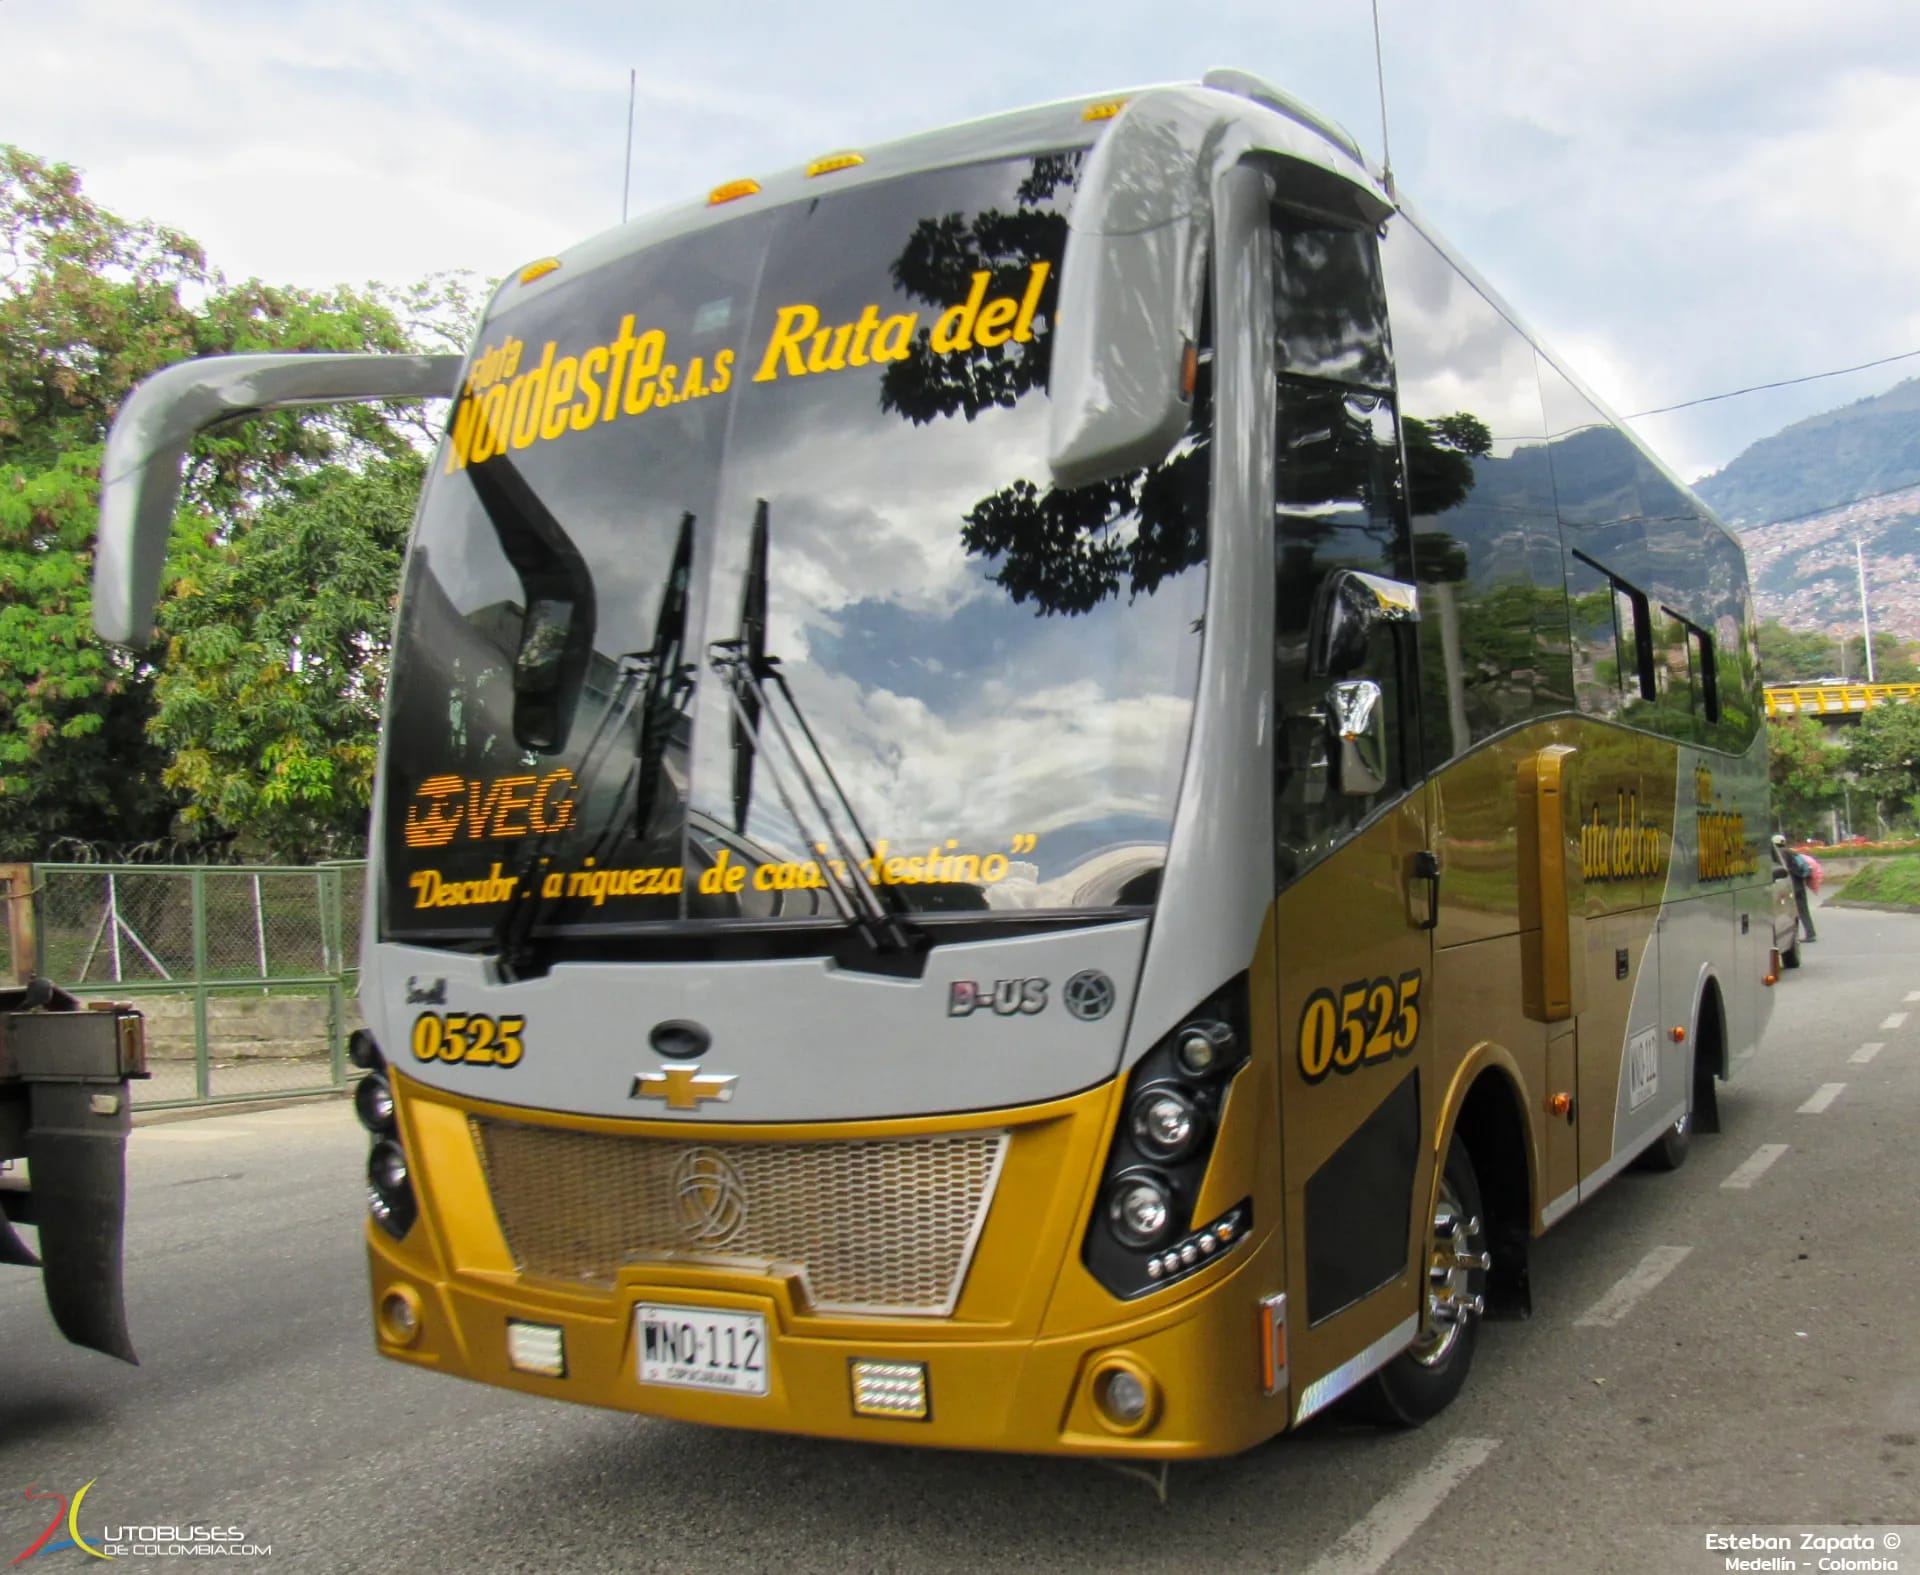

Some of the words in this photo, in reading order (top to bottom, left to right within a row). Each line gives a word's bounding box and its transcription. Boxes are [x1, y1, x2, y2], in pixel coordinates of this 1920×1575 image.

[752, 303, 918, 382] Ruta
[930, 261, 1050, 354] del
[444, 314, 667, 475] Nordeste
[409, 863, 531, 909] “Descubr
[568, 857, 684, 906] riqueza
[700, 850, 746, 895] de
[1581, 802, 1609, 882] uta
[412, 1011, 525, 1069] 0525
[1298, 968, 1422, 1085] 0525
